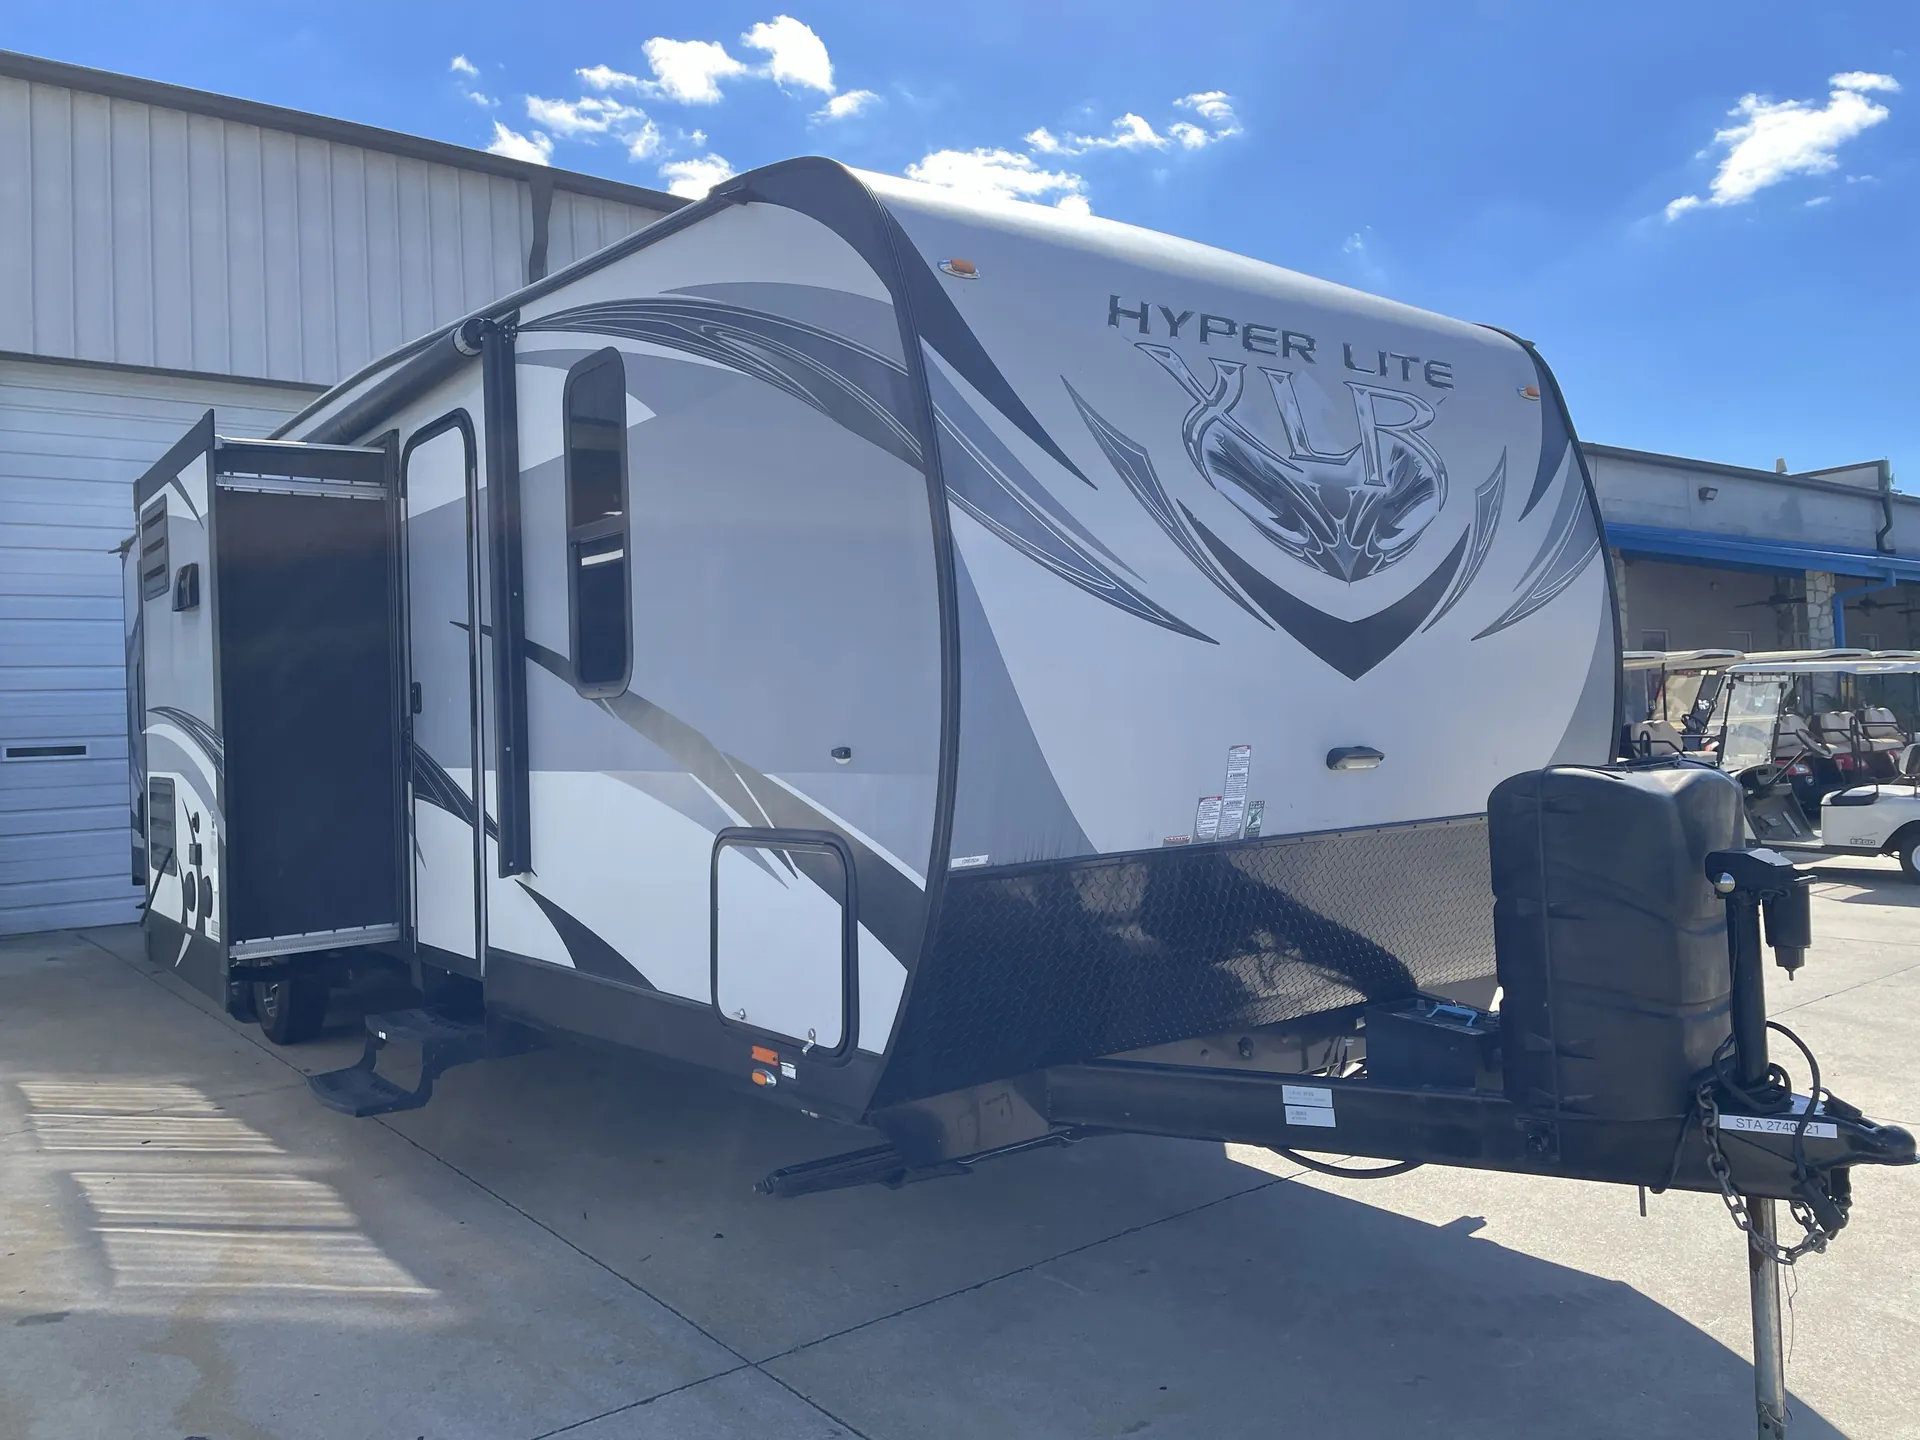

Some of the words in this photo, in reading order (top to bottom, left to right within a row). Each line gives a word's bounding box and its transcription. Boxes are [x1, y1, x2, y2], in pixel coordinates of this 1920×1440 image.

[1107, 294, 1317, 365] HYPER
[1342, 341, 1455, 390] LITE
[1133, 342, 1449, 513] XLR
[1736, 1117, 1763, 1130] STA
[1766, 1120, 1820, 1135] 274021
